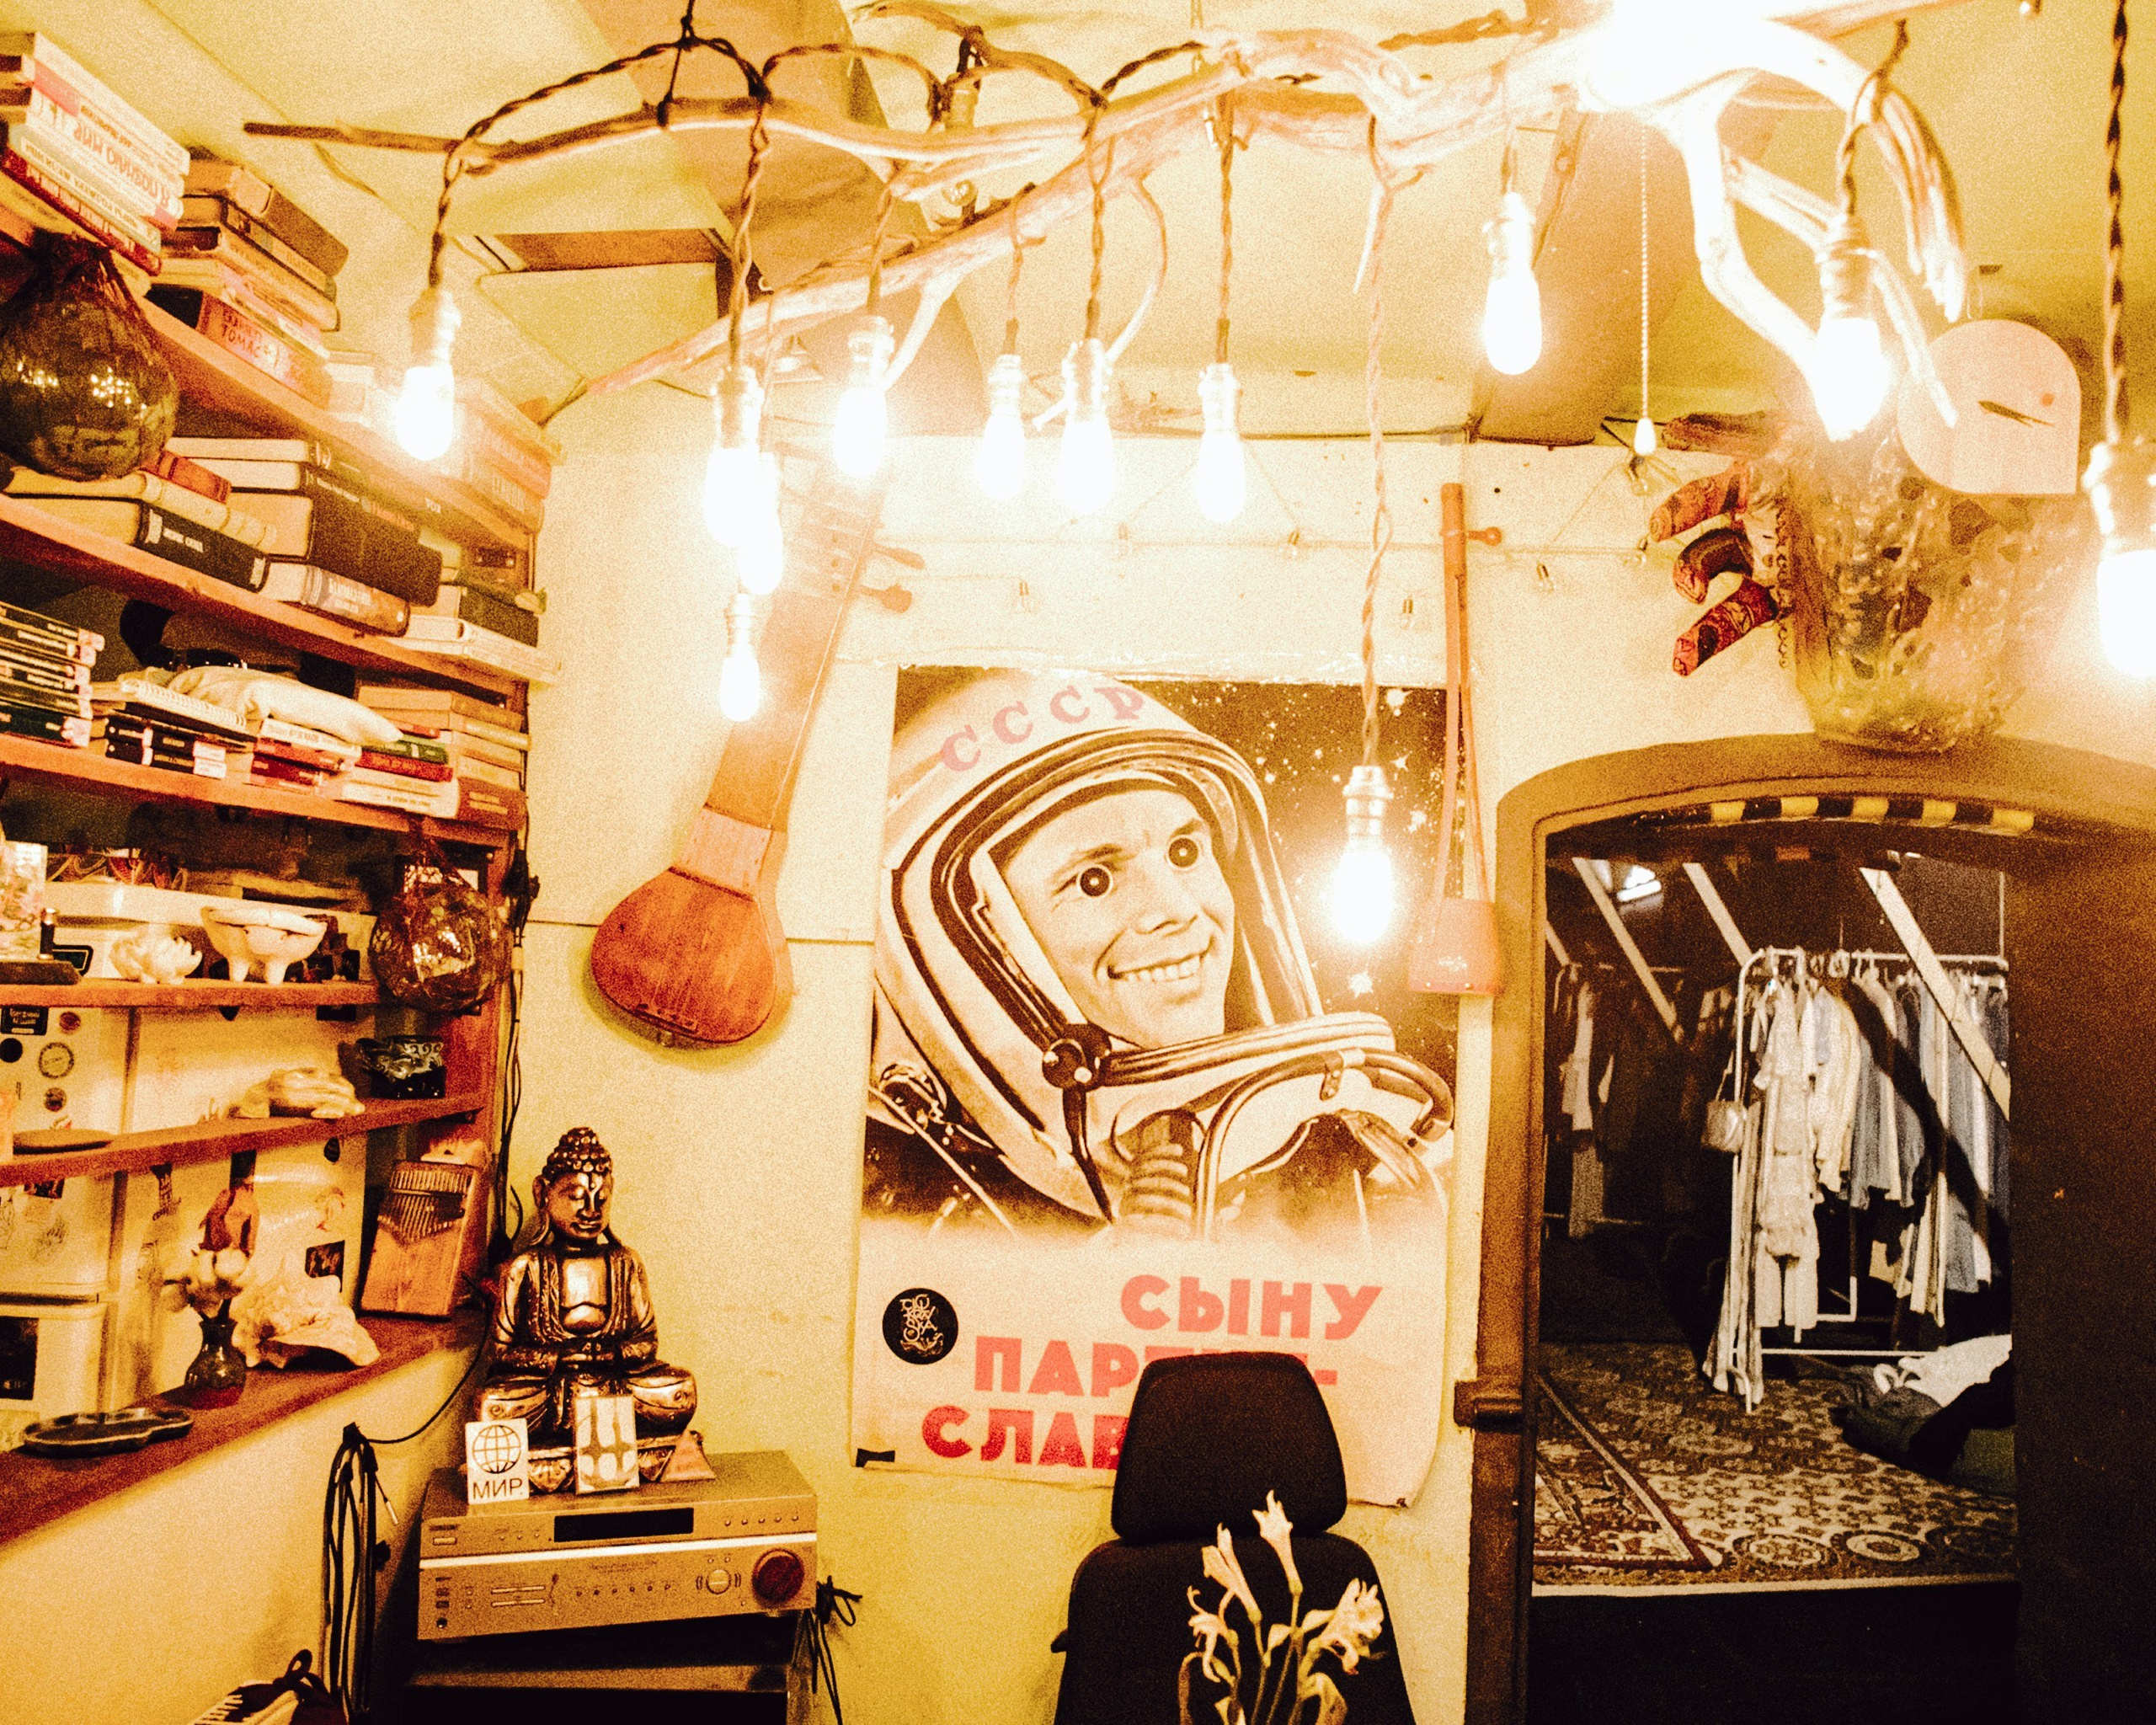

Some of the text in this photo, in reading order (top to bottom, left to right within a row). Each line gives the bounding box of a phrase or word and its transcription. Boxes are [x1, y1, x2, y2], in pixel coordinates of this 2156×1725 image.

[940, 686, 1144, 772] СССР
[1121, 1274, 1383, 1340] СЫНУ
[974, 1336, 1337, 1397] ПАР-
[922, 1405, 1130, 1471] СЛАВ
